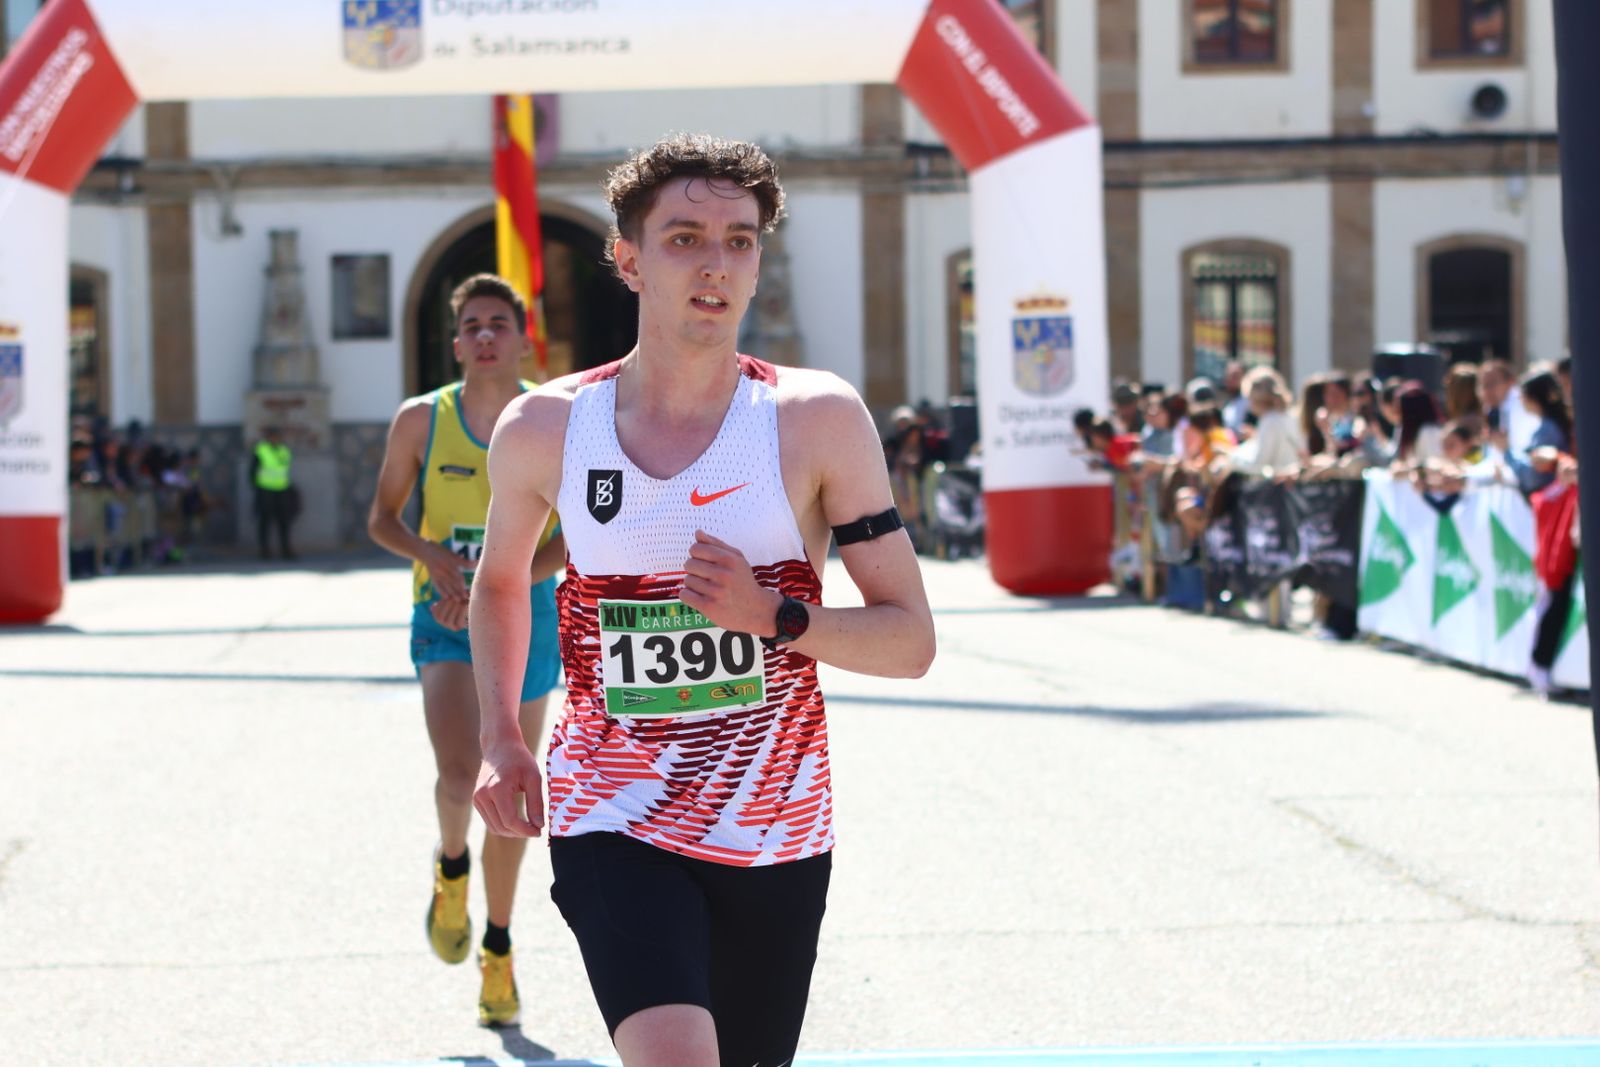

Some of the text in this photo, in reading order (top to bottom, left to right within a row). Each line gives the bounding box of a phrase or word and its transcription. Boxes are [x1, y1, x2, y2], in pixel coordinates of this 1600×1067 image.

[473, 35, 630, 56] Salamanca
[603, 606, 637, 628] XIV
[641, 606, 667, 618] SAN
[609, 630, 755, 684] 1390
